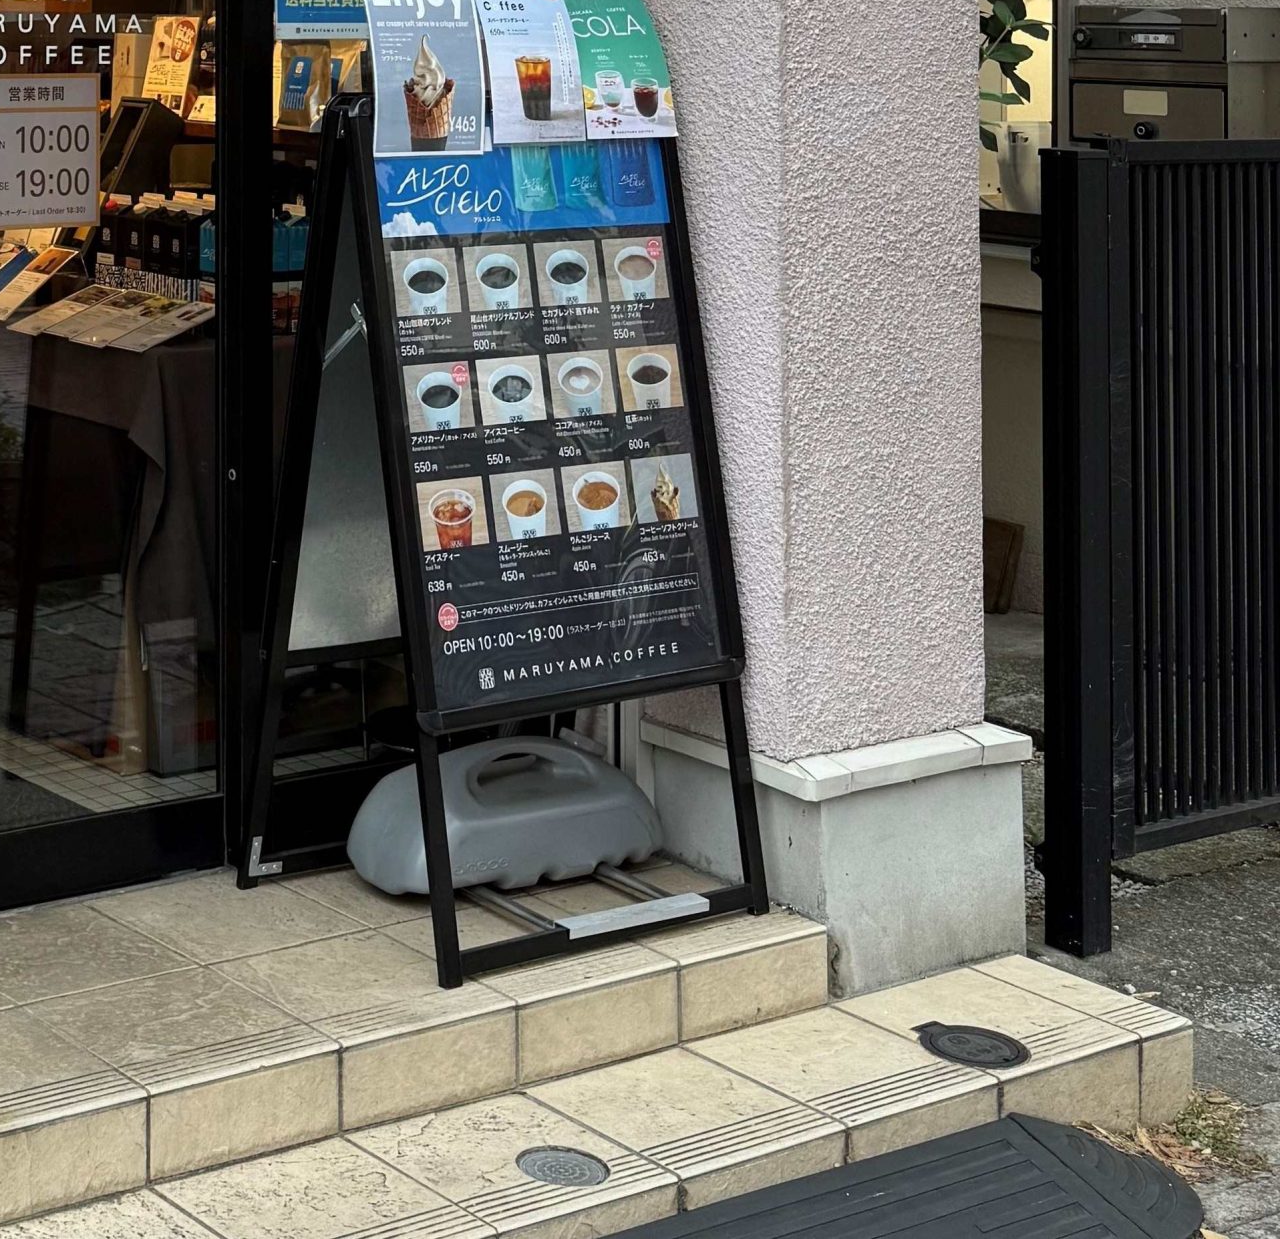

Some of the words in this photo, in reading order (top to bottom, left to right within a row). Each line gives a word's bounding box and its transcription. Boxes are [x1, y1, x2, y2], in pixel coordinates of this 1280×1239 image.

[570, 14, 647, 38] COLA
[8, 86, 65, 102] 営業時間
[15, 124, 90, 154] 10:00
[15, 167, 90, 198] 19:00
[396, 163, 470, 195] ALTO
[434, 189, 502, 216] CIELO
[398, 317, 453, 329] 丸山珈琲のブレンド
[544, 334, 567, 345] 600円
[613, 328, 636, 339] 550円
[400, 345, 425, 356] 550円
[473, 339, 497, 351] 600円
[483, 426, 526, 438] アイスコーヒー
[628, 438, 651, 450] 600円
[558, 446, 582, 457] 450円
[486, 453, 512, 465] 550円
[413, 461, 438, 473] 550円
[639, 520, 699, 536] コーヒーソフトクリーム
[570, 532, 611, 544] りんごジュース
[498, 542, 529, 554] スムージー
[424, 553, 461, 563] アイスティー
[641, 551, 666, 563] 463円
[573, 560, 597, 572] 450円
[500, 570, 526, 582] 450円
[427, 580, 453, 593] 638円
[443, 638, 476, 655] OPEN
[503, 654, 605, 682] MARUYAMA
[612, 641, 679, 663] COFFEE
